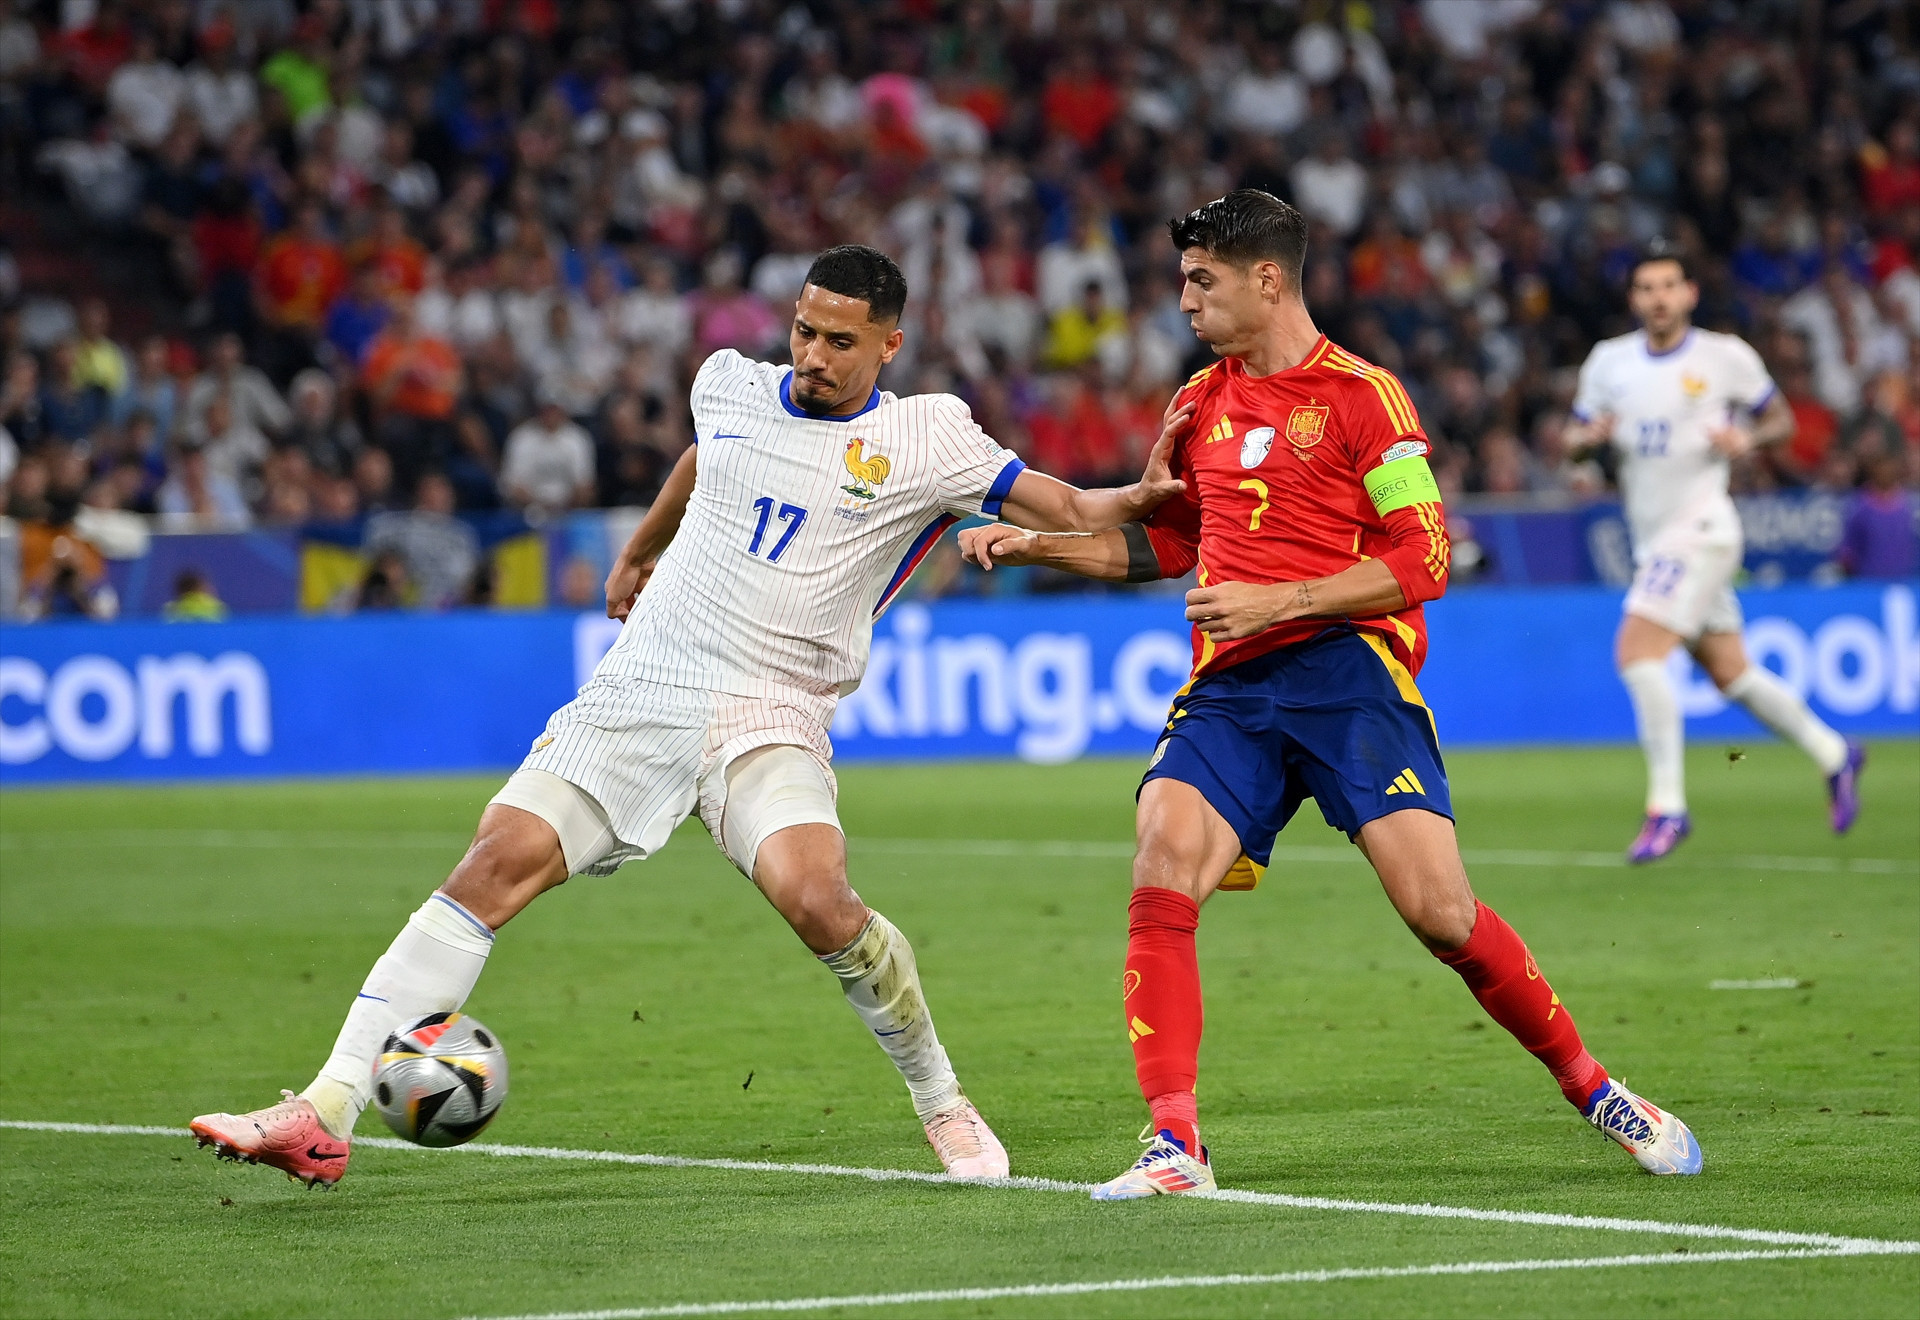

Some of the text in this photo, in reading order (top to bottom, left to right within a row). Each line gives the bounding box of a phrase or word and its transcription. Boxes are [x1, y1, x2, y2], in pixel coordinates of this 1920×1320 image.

[1637, 418, 1671, 457] 22
[748, 496, 808, 564] 17
[1238, 479, 1270, 531] 7
